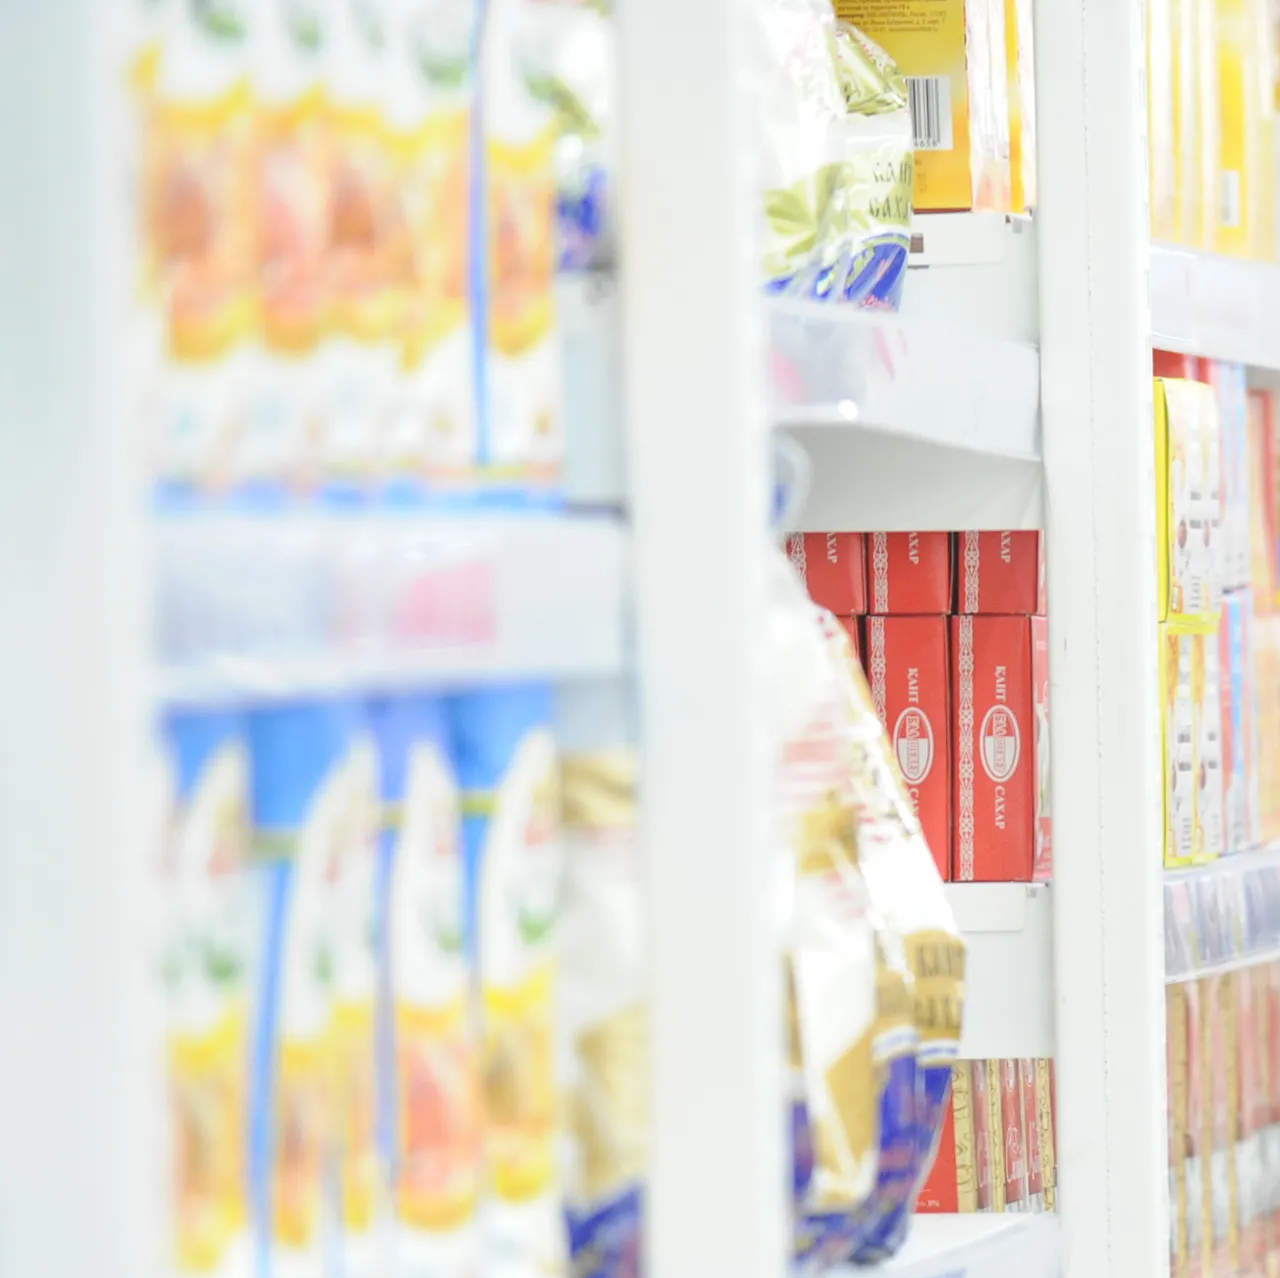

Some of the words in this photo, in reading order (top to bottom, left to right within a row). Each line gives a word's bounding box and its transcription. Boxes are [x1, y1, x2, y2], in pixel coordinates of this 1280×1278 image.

[909, 532, 919, 565] АХАР
[1000, 531, 1011, 564] АХАР
[994, 785, 1006, 829] САХАР
